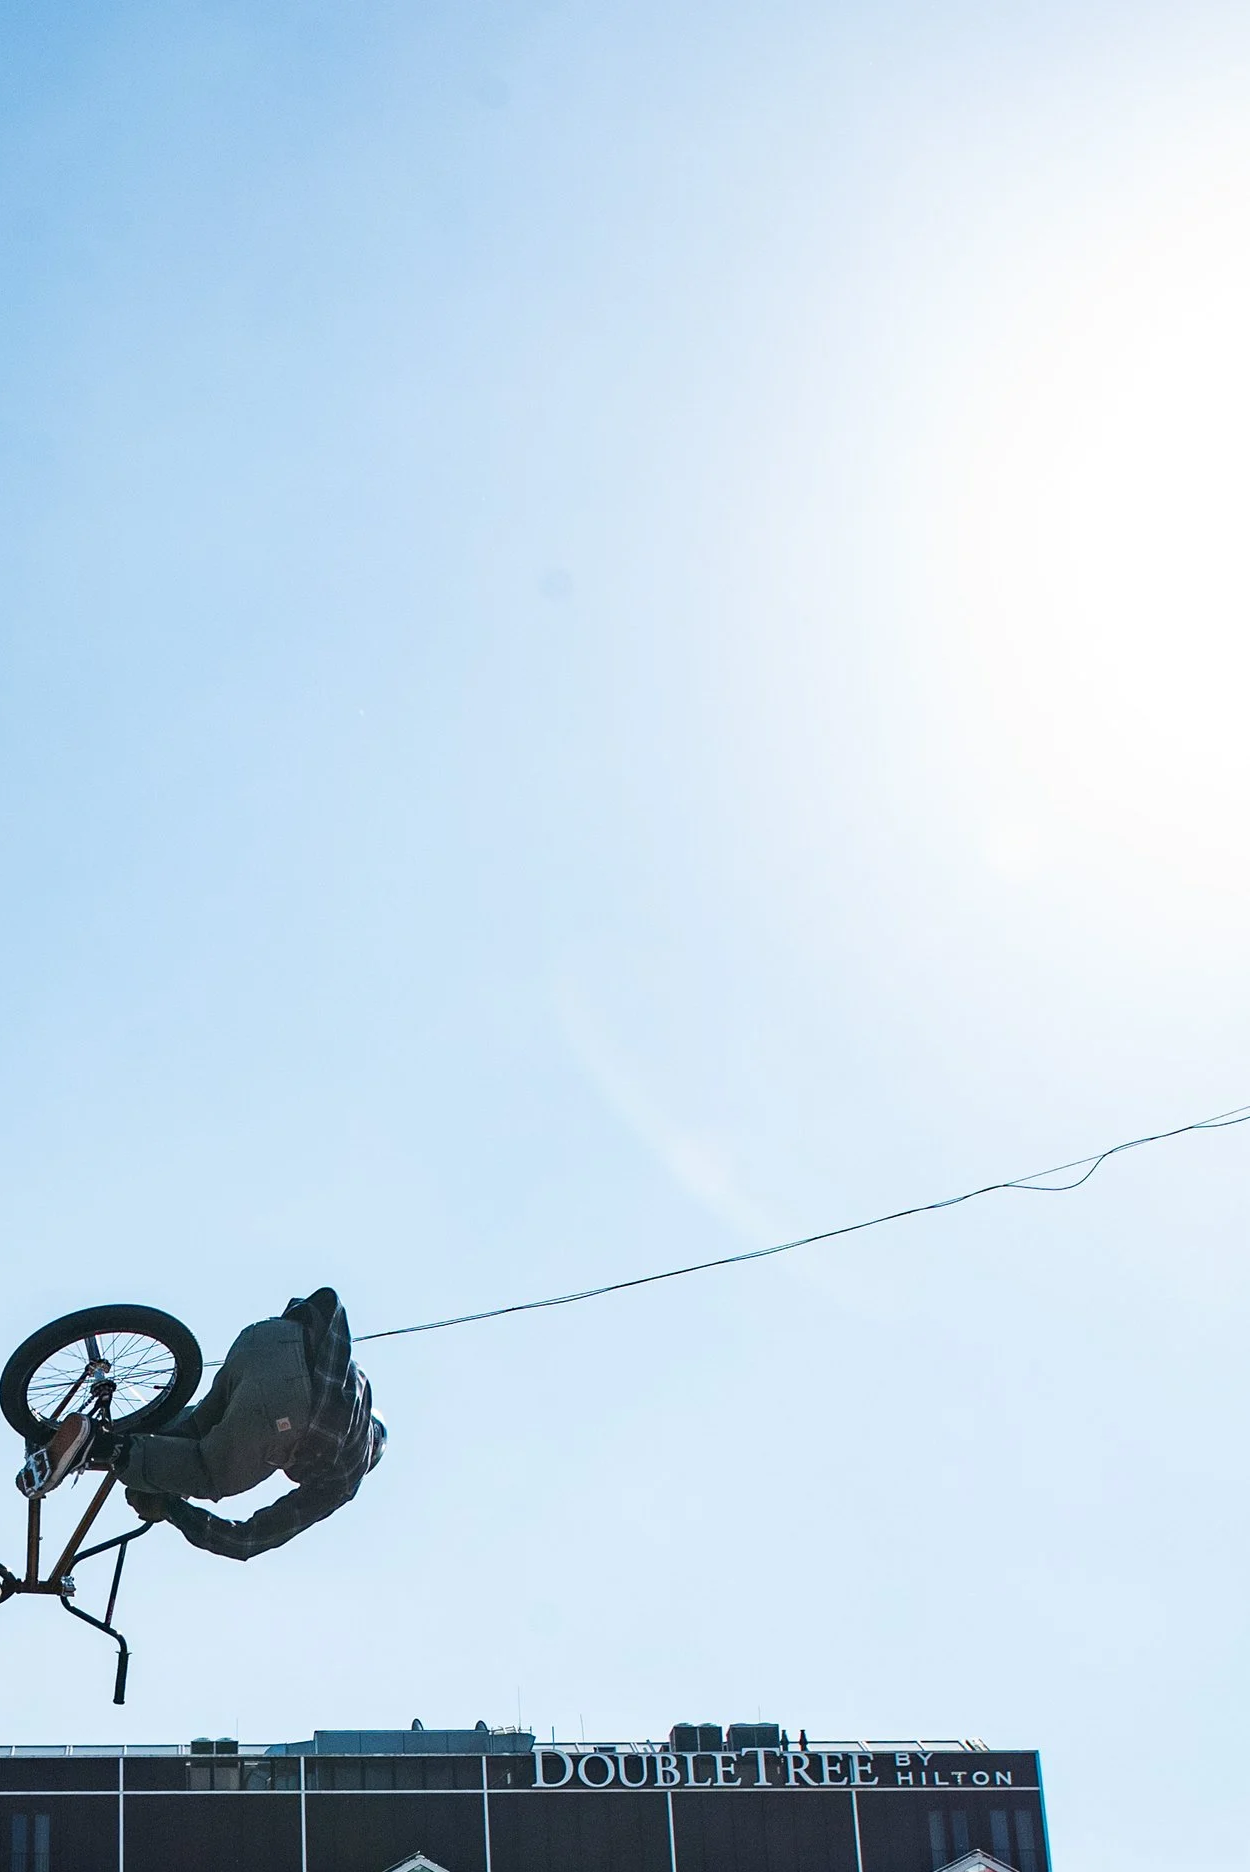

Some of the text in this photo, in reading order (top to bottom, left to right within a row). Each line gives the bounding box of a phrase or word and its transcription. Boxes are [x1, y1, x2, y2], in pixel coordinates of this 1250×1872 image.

[895, 1752, 933, 1767] BY
[531, 1747, 880, 1789] DOUBLETREE
[897, 1770, 1013, 1786] HILTON
